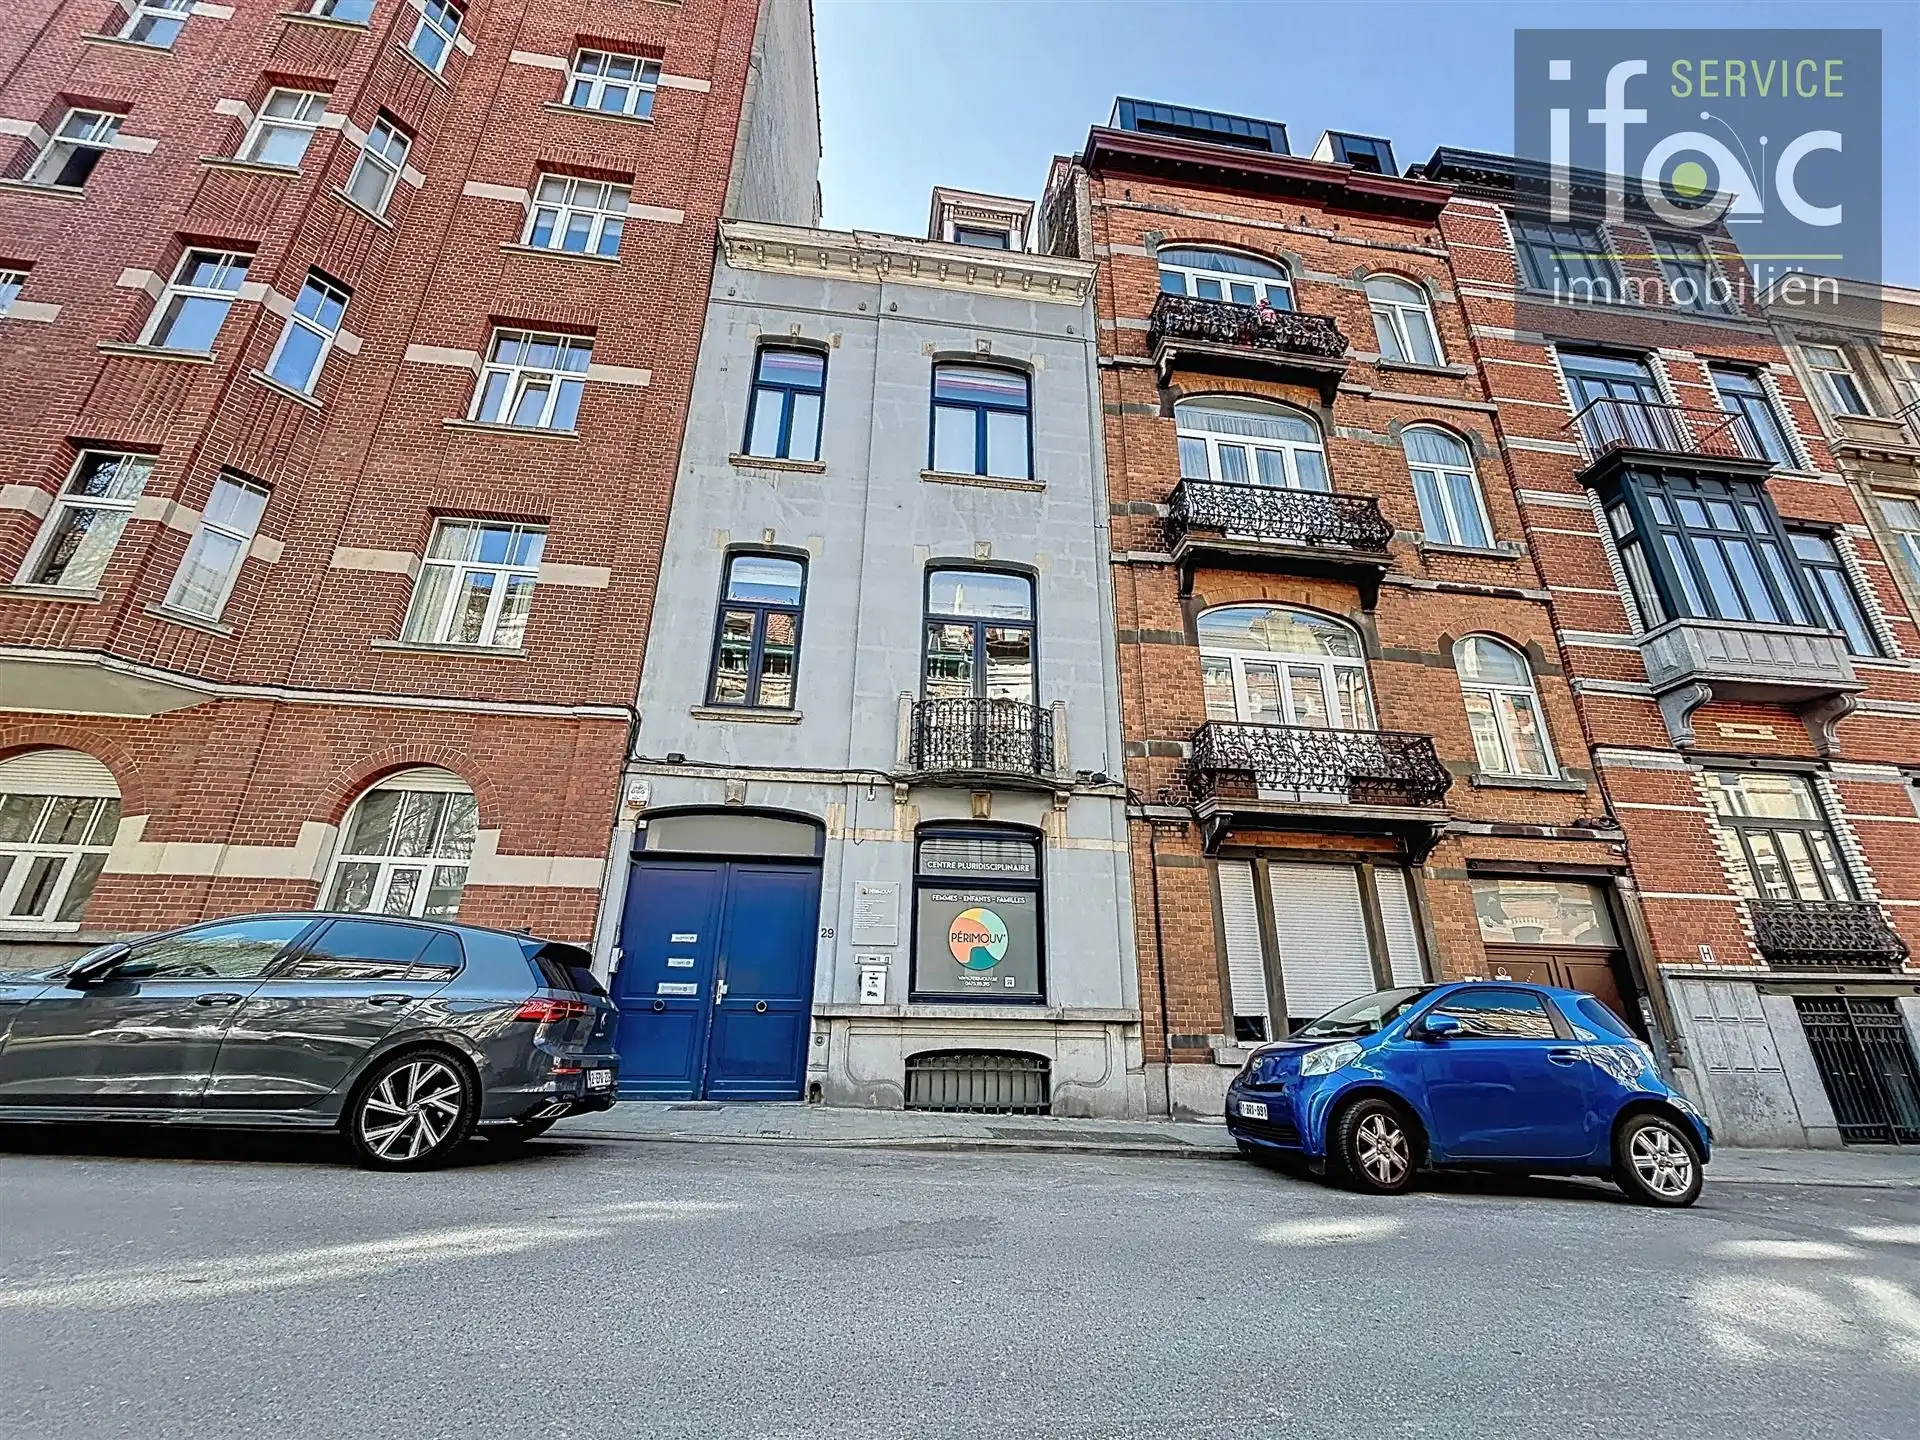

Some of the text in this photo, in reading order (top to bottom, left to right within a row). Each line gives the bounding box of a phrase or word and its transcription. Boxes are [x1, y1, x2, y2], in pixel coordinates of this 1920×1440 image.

[927, 861, 1030, 872] CENTRE PLURIDISCIPLINAIRE
[932, 894, 958, 902] FEMMES
[963, 895, 991, 903] ENFANTS
[996, 896, 1025, 904] FAMILLES
[821, 928, 834, 938] 29
[1701, 947, 1712, 960] H
